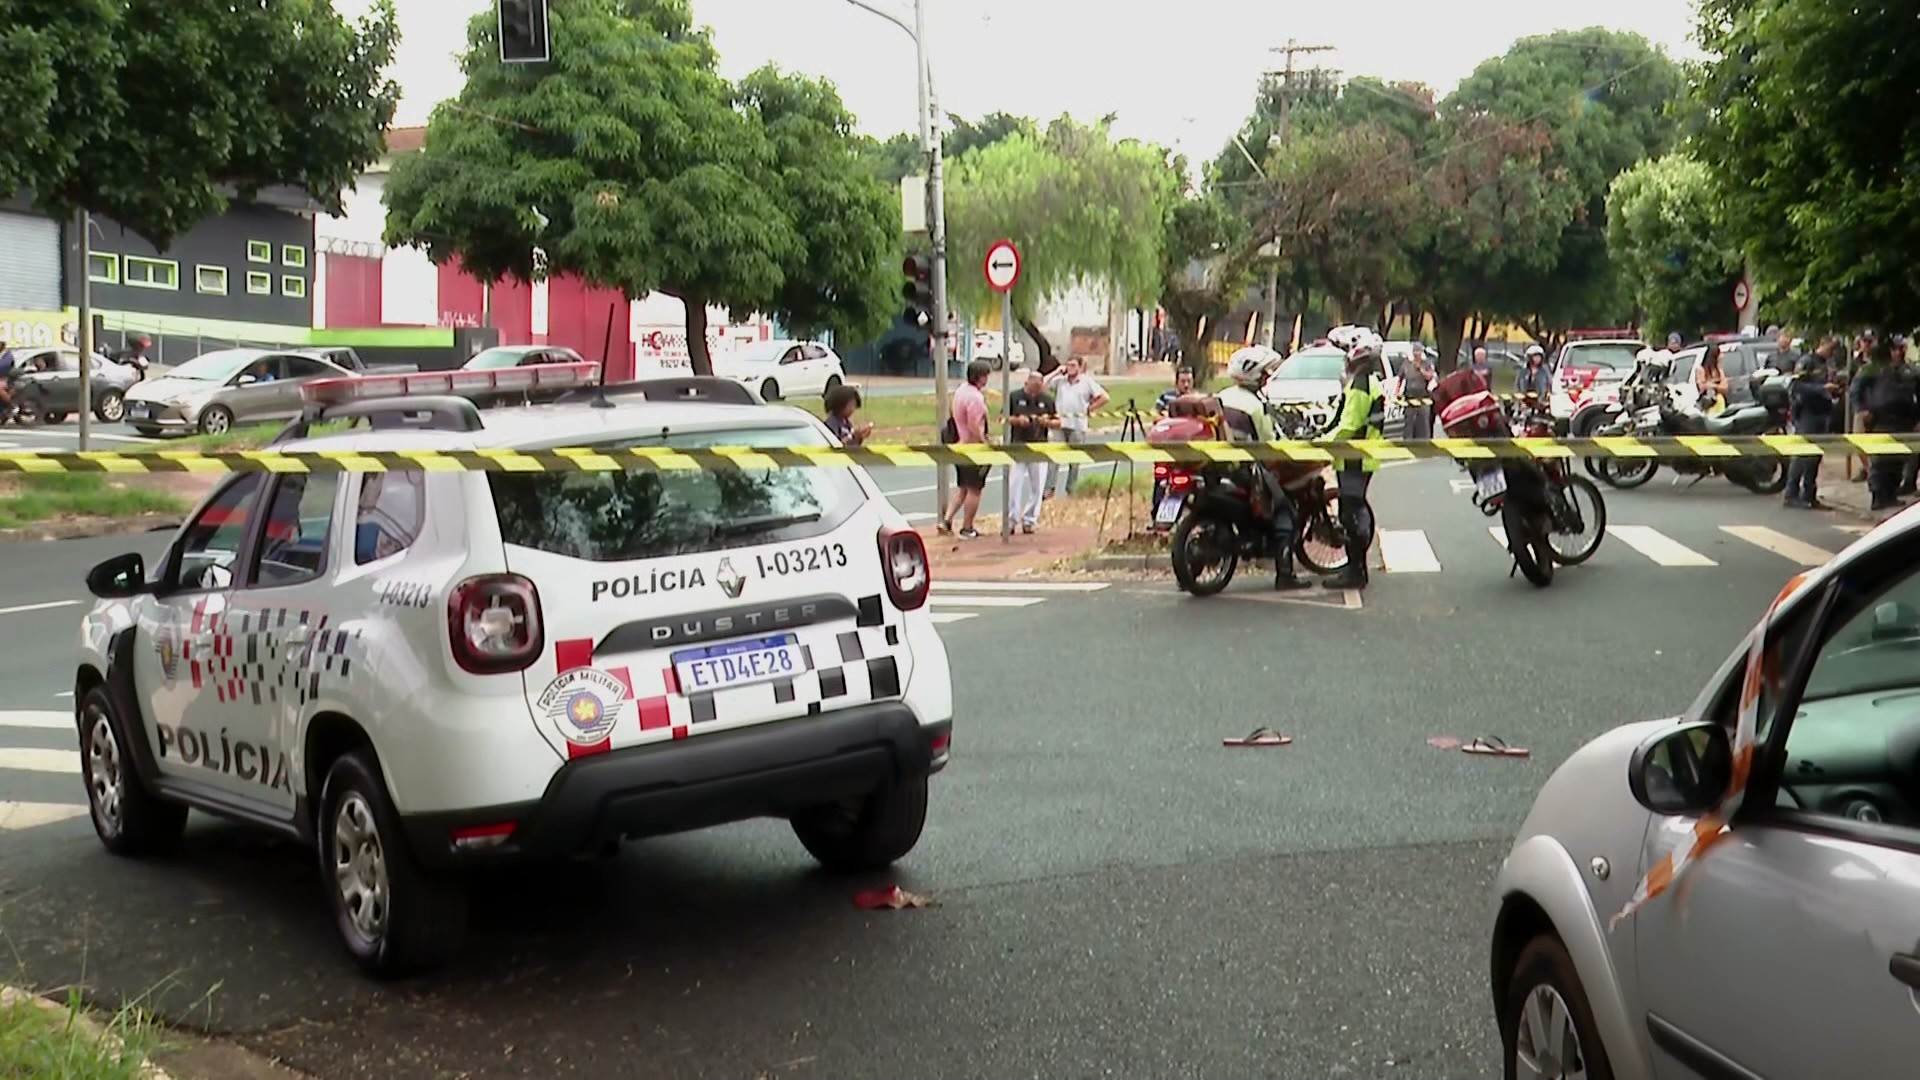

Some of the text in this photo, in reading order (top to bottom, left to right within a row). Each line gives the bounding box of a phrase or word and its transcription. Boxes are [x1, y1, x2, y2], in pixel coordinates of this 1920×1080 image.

[592, 543, 847, 602] POLÍCIA I-03213
[651, 603, 817, 641] DUSTER
[580, 671, 620, 694] MILITAR
[691, 648, 793, 686] ETD4E28
[157, 722, 292, 795] POLÍCIA
